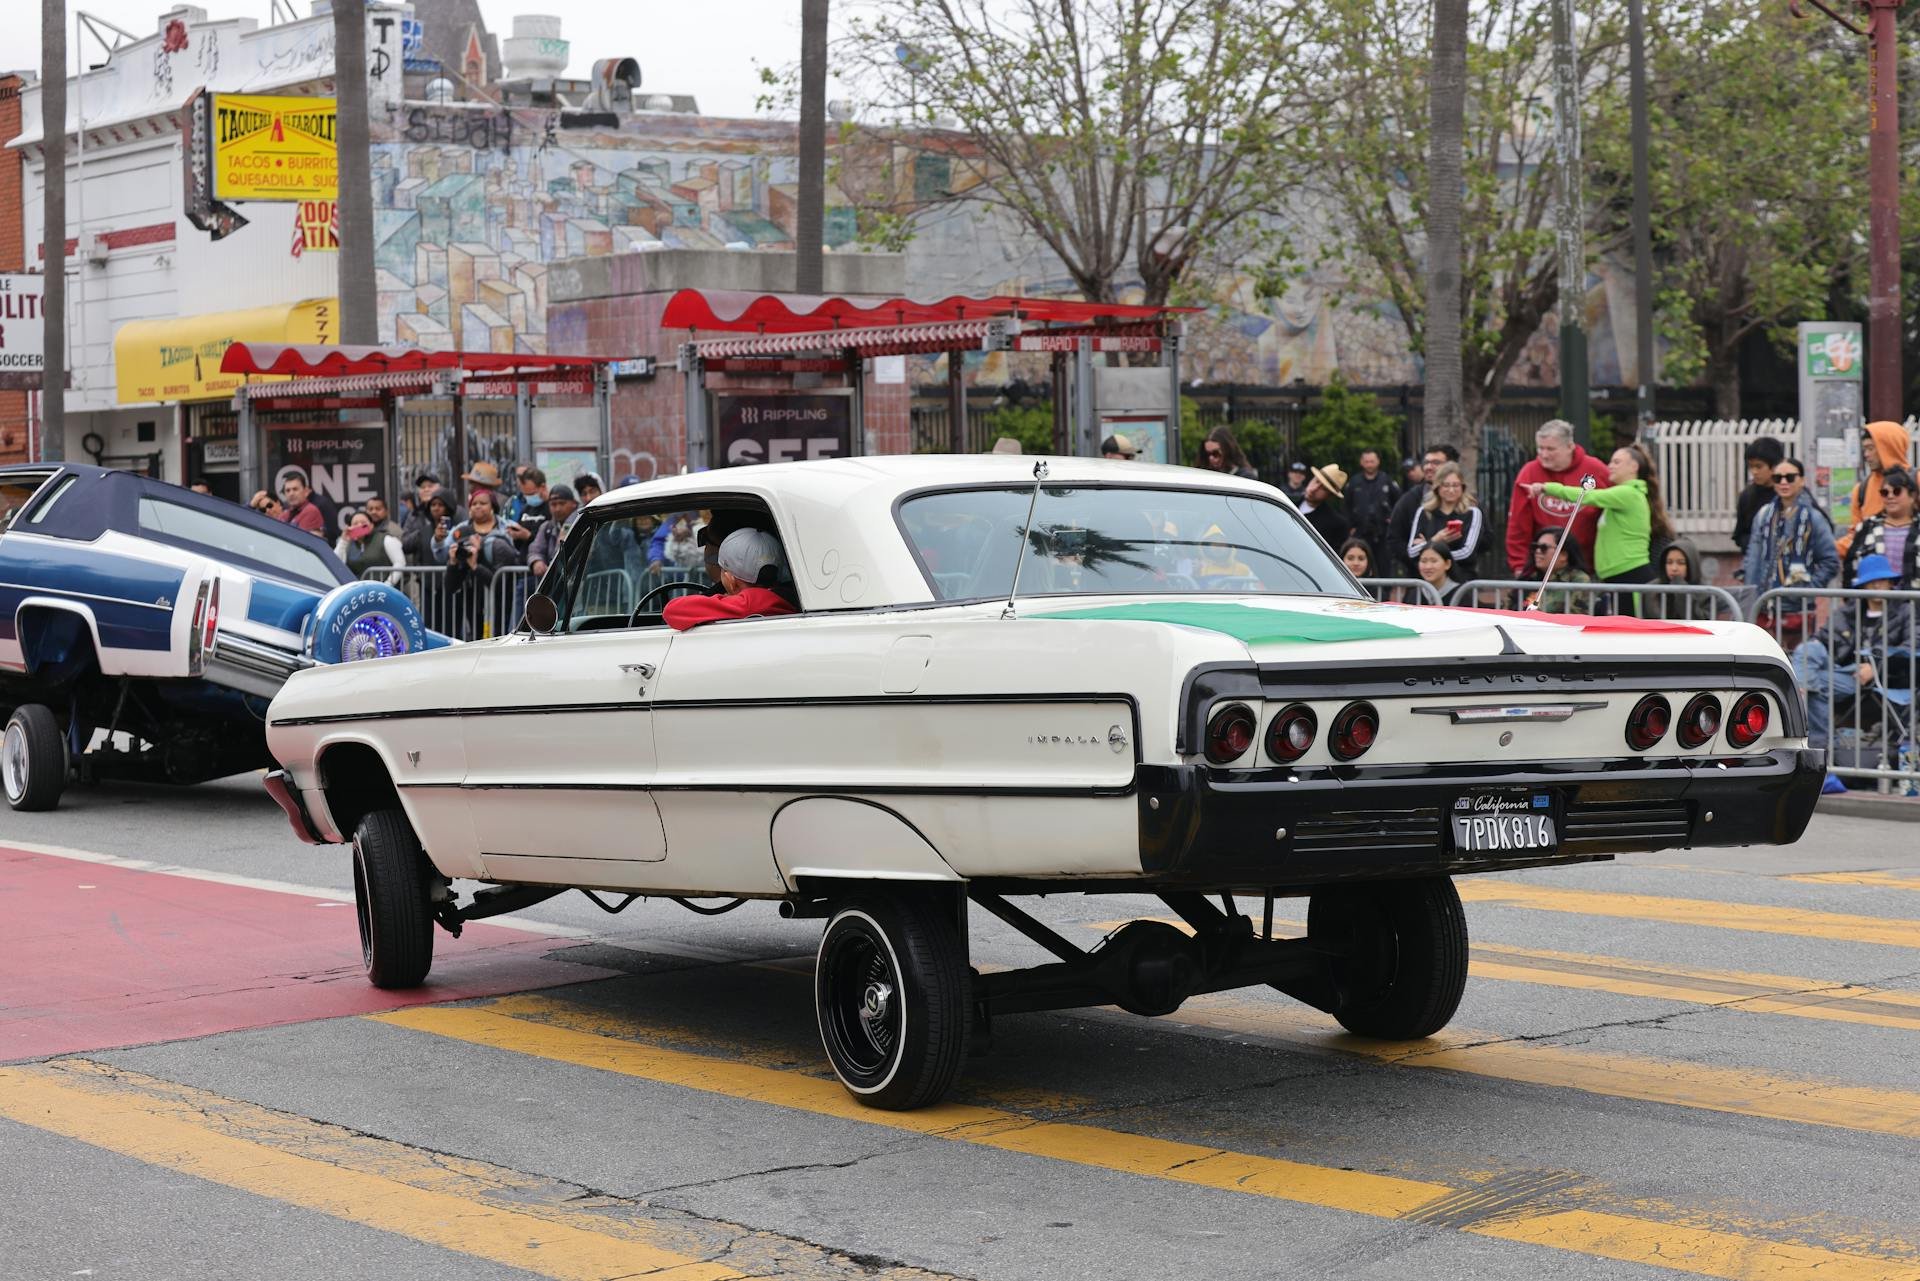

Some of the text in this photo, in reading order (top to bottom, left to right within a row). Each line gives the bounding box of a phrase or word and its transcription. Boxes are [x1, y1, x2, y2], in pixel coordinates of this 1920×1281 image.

[218, 108, 273, 144] TAQUERIA
[227, 156, 271, 169] TACOS
[227, 172, 305, 187] QUESADILLA
[1042, 335, 1151, 351] RAPID RAPID
[485, 382, 584, 394] RAPID RAPID
[763, 409, 828, 421] RIPPLING
[306, 439, 365, 450] RIPPLING
[275, 463, 378, 504] ONE
[332, 591, 387, 634] FOREVER
[1403, 673, 1618, 687] CHEVROLET
[1027, 735, 1101, 745] IMPALA
[1473, 795, 1529, 817] California
[1459, 815, 1551, 851] 7PDK816
